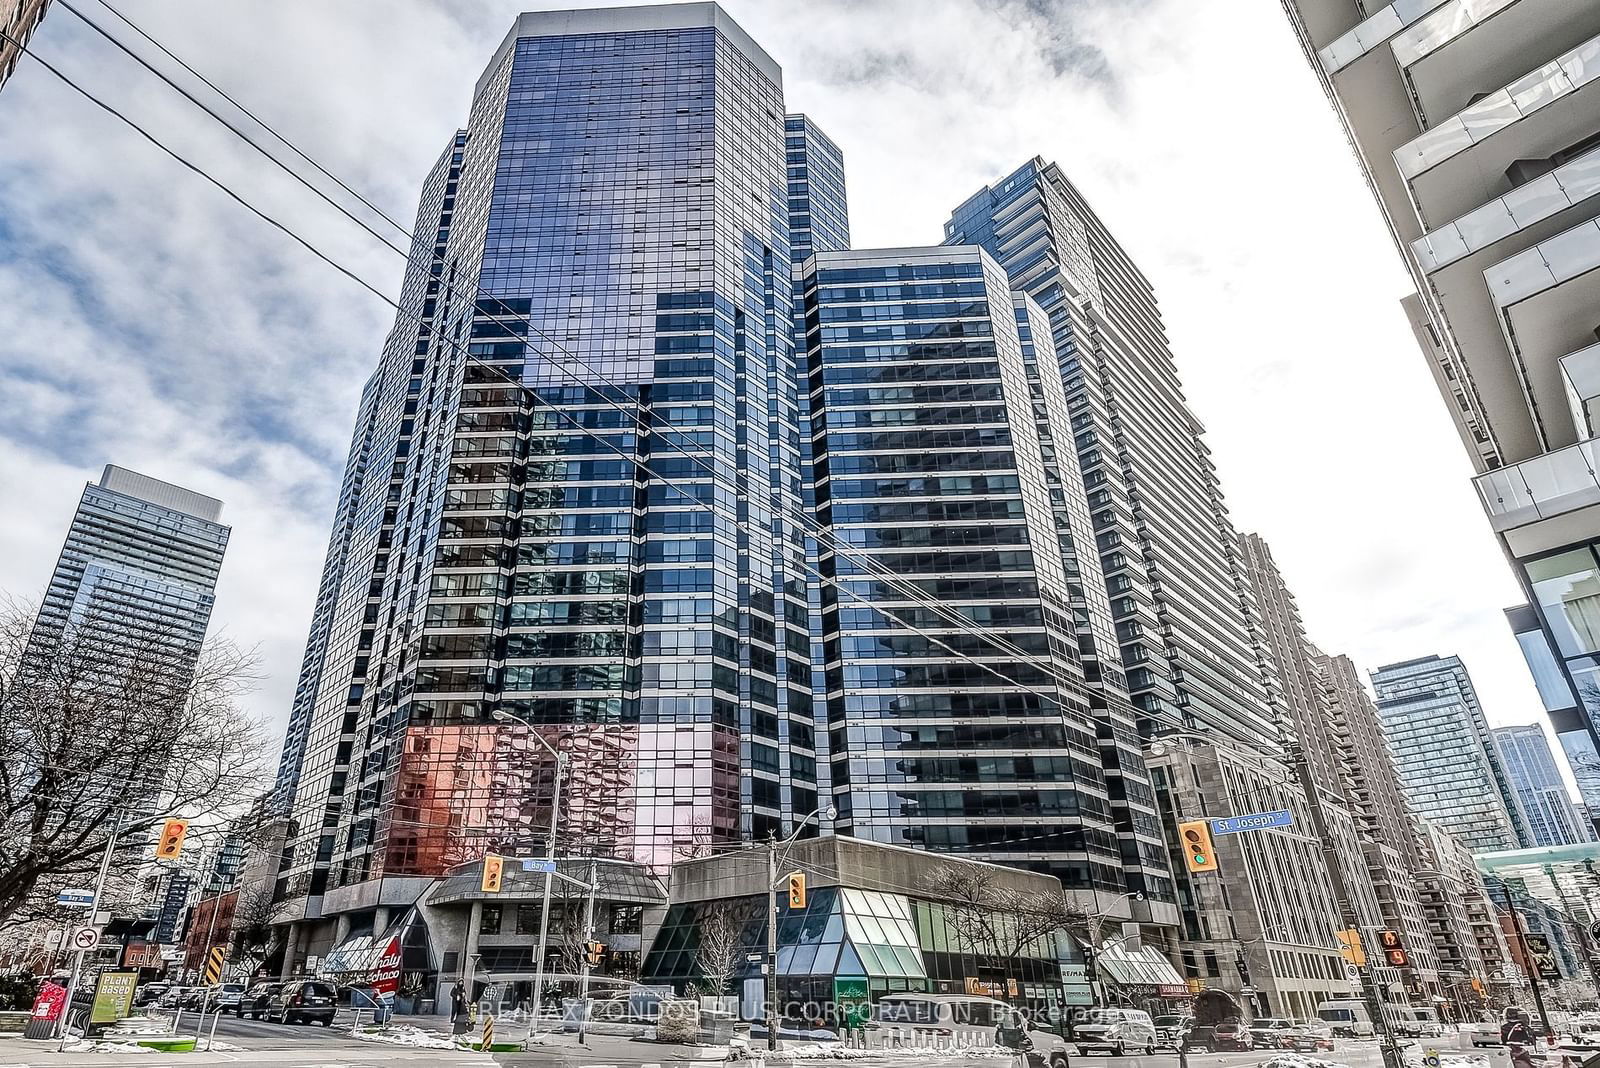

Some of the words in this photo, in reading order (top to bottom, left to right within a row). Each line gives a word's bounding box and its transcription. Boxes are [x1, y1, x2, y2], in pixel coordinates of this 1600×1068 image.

[1218, 820, 1233, 831] St.
[1237, 814, 1275, 829] Joseph
[531, 861, 544, 871] Bay
